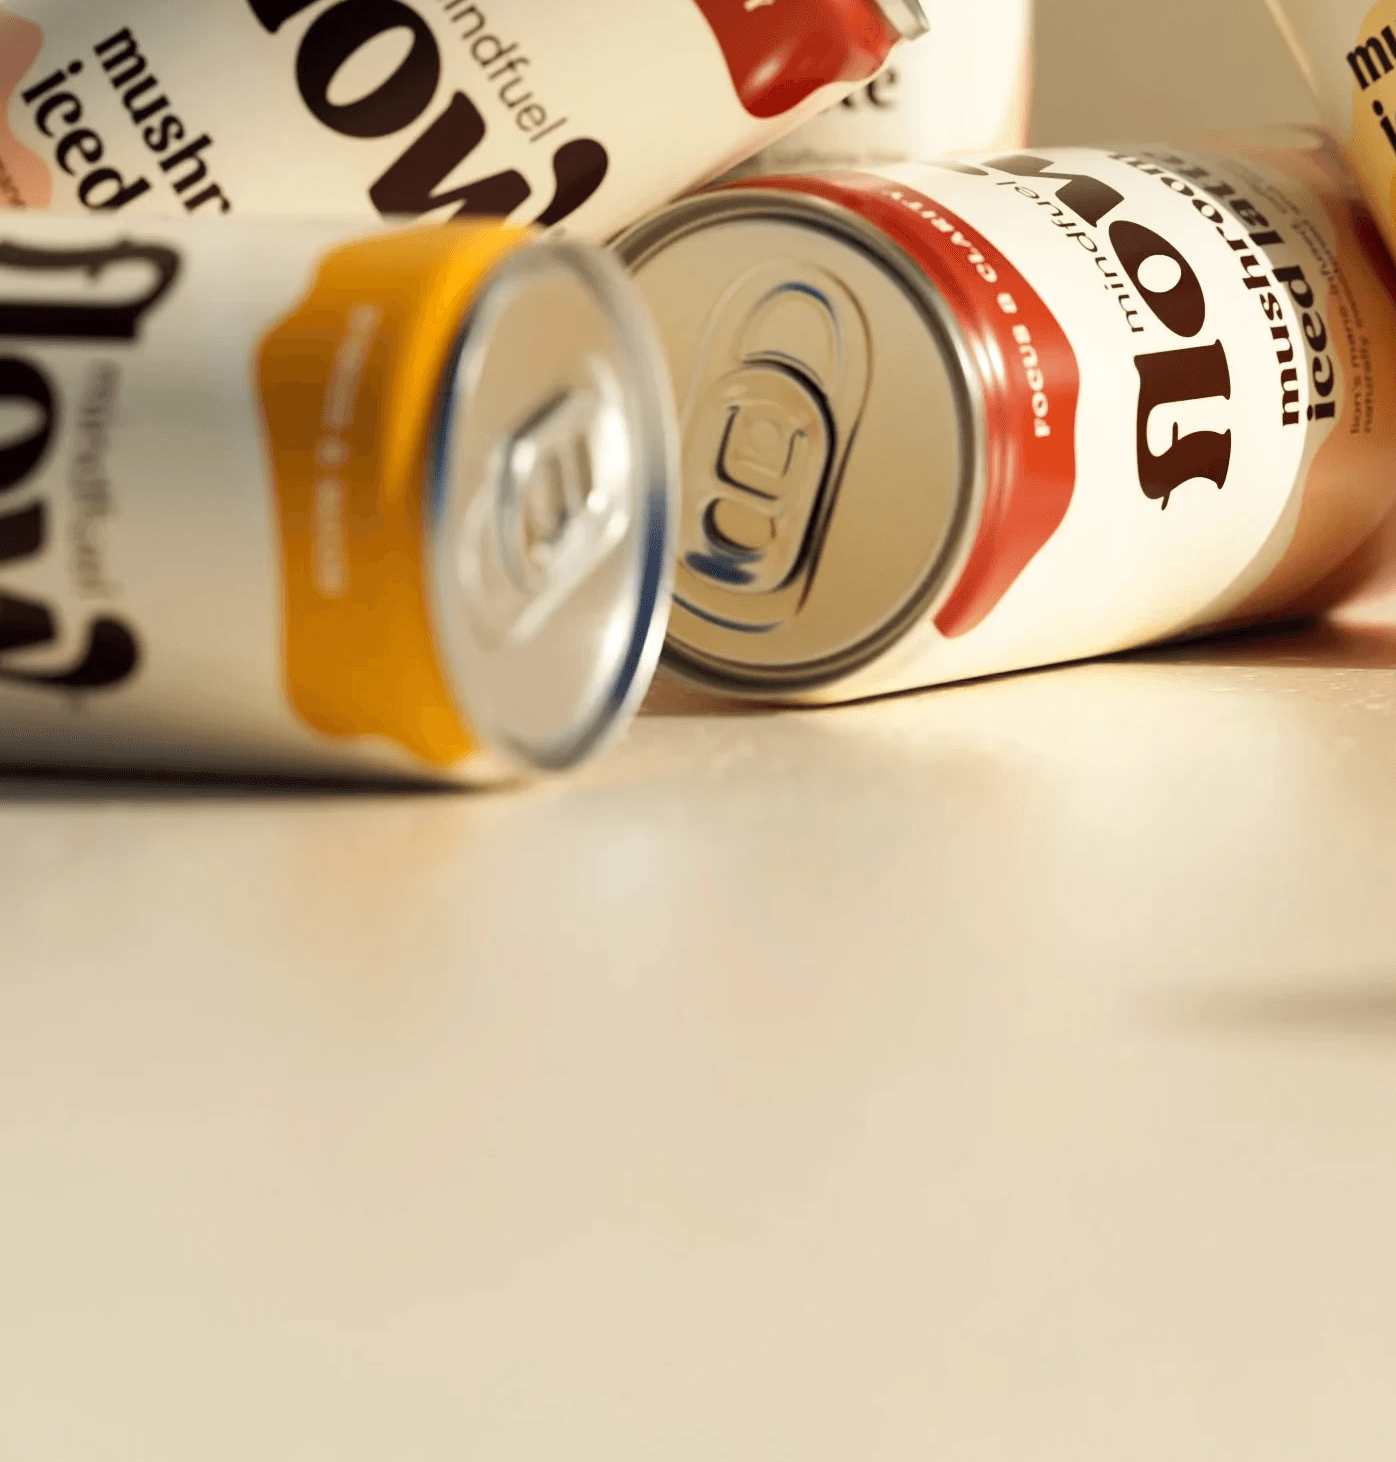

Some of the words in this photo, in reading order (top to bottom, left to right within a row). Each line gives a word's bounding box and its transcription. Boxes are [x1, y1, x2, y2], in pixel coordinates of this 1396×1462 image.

[20, 59, 151, 212] iced
[93, 27, 231, 216] mushr
[918, 154, 1232, 511] flow
[995, 180, 1145, 334] mindfuel
[1106, 150, 1300, 428] mushroom
[1011, 324, 1051, 438] FOCUS
[1272, 264, 1336, 421] iced
